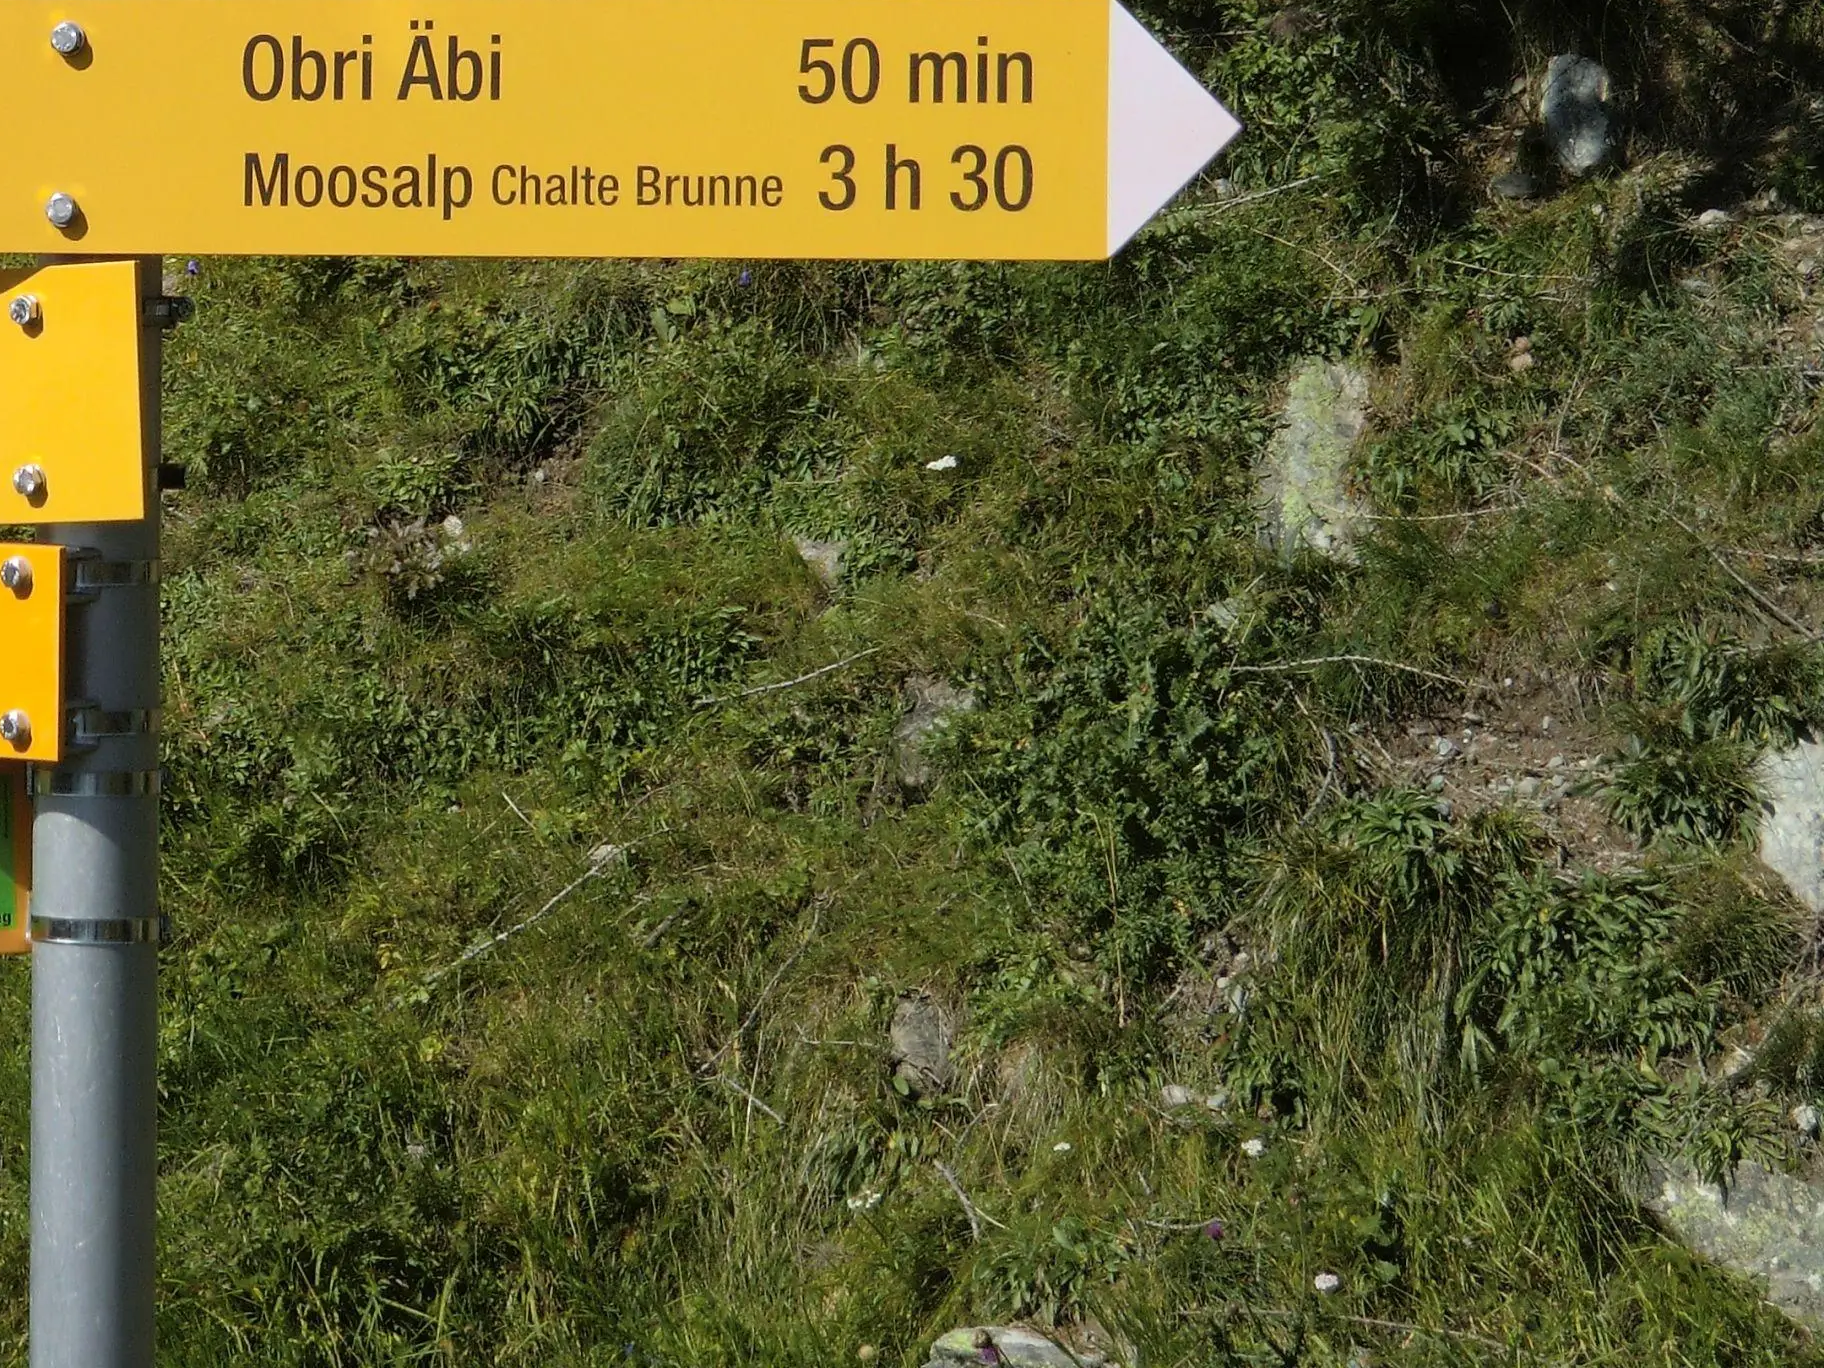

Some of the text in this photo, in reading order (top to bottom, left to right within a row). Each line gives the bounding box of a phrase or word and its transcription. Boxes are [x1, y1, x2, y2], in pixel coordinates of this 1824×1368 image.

[242, 20, 1034, 104] Obri Äbi 50 min
[243, 144, 1034, 219] Moosalp Chalte Brunne 3 h 30
